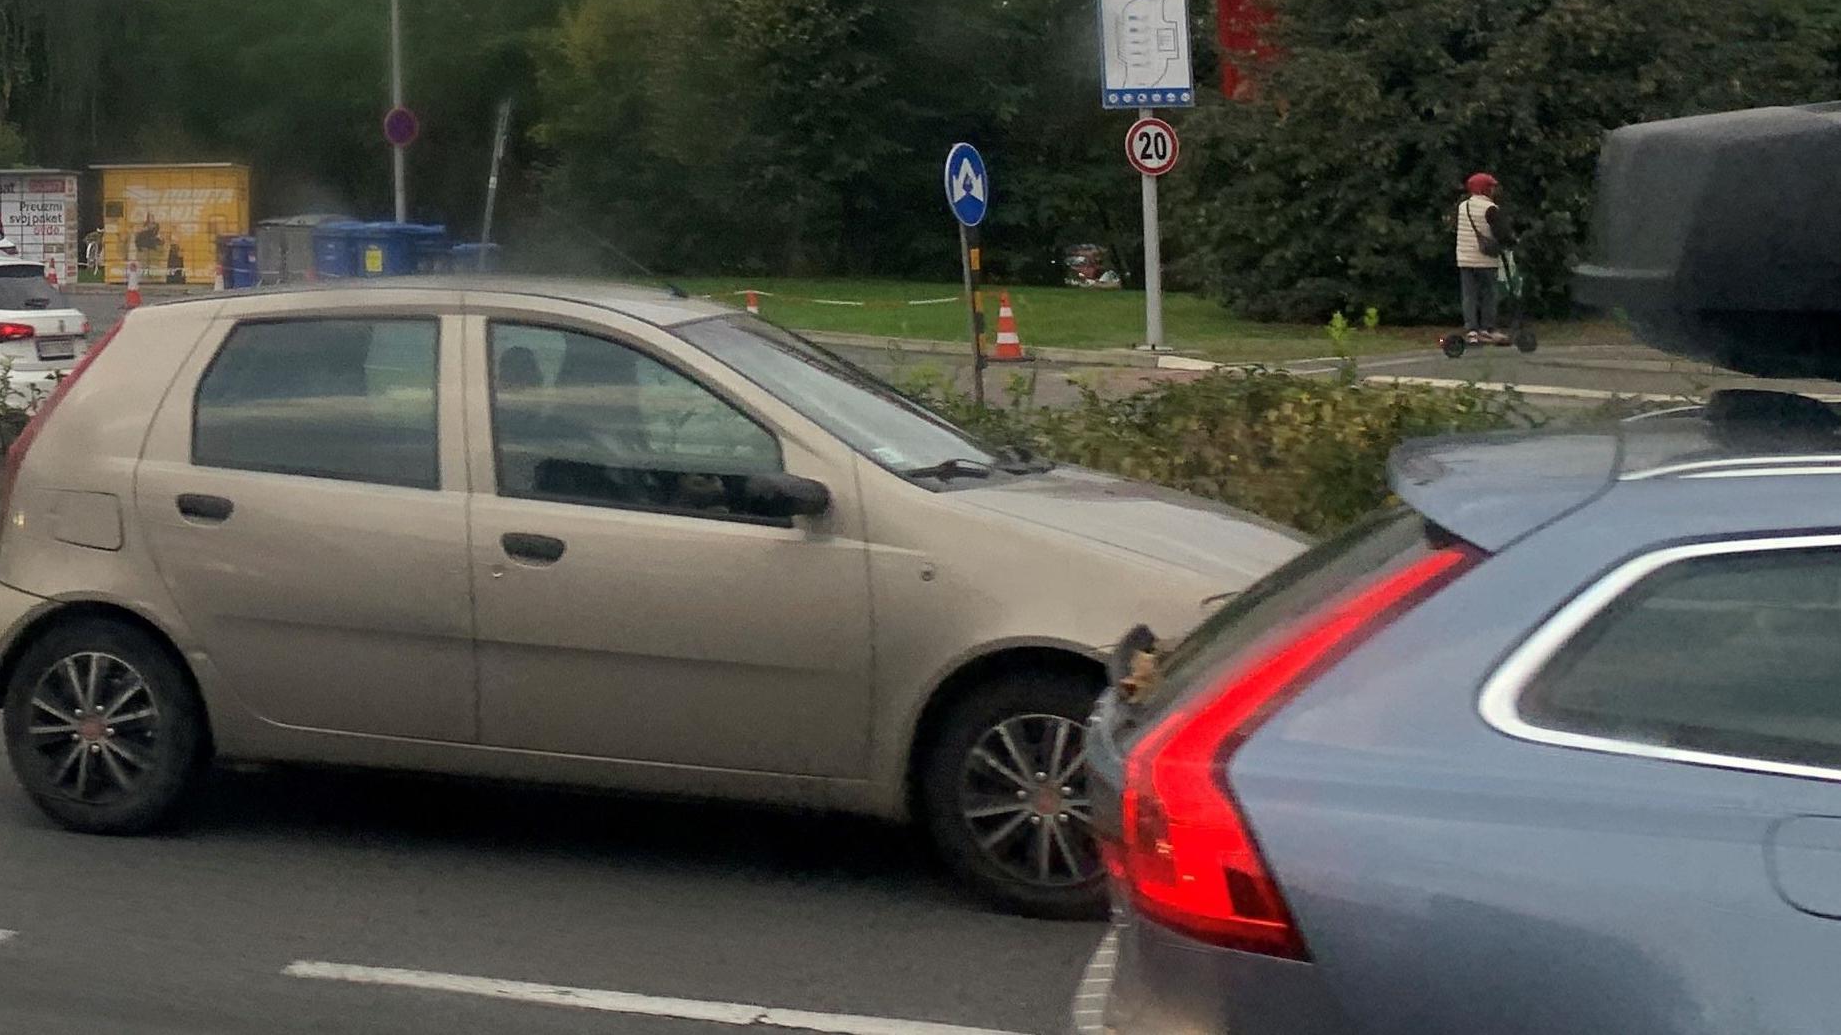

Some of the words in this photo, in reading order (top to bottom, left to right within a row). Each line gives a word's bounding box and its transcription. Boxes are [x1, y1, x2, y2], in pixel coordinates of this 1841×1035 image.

[1138, 131, 1168, 161] 20
[19, 201, 63, 212] Preuzmi
[9, 213, 31, 226] svoj
[32, 214, 63, 225] paket
